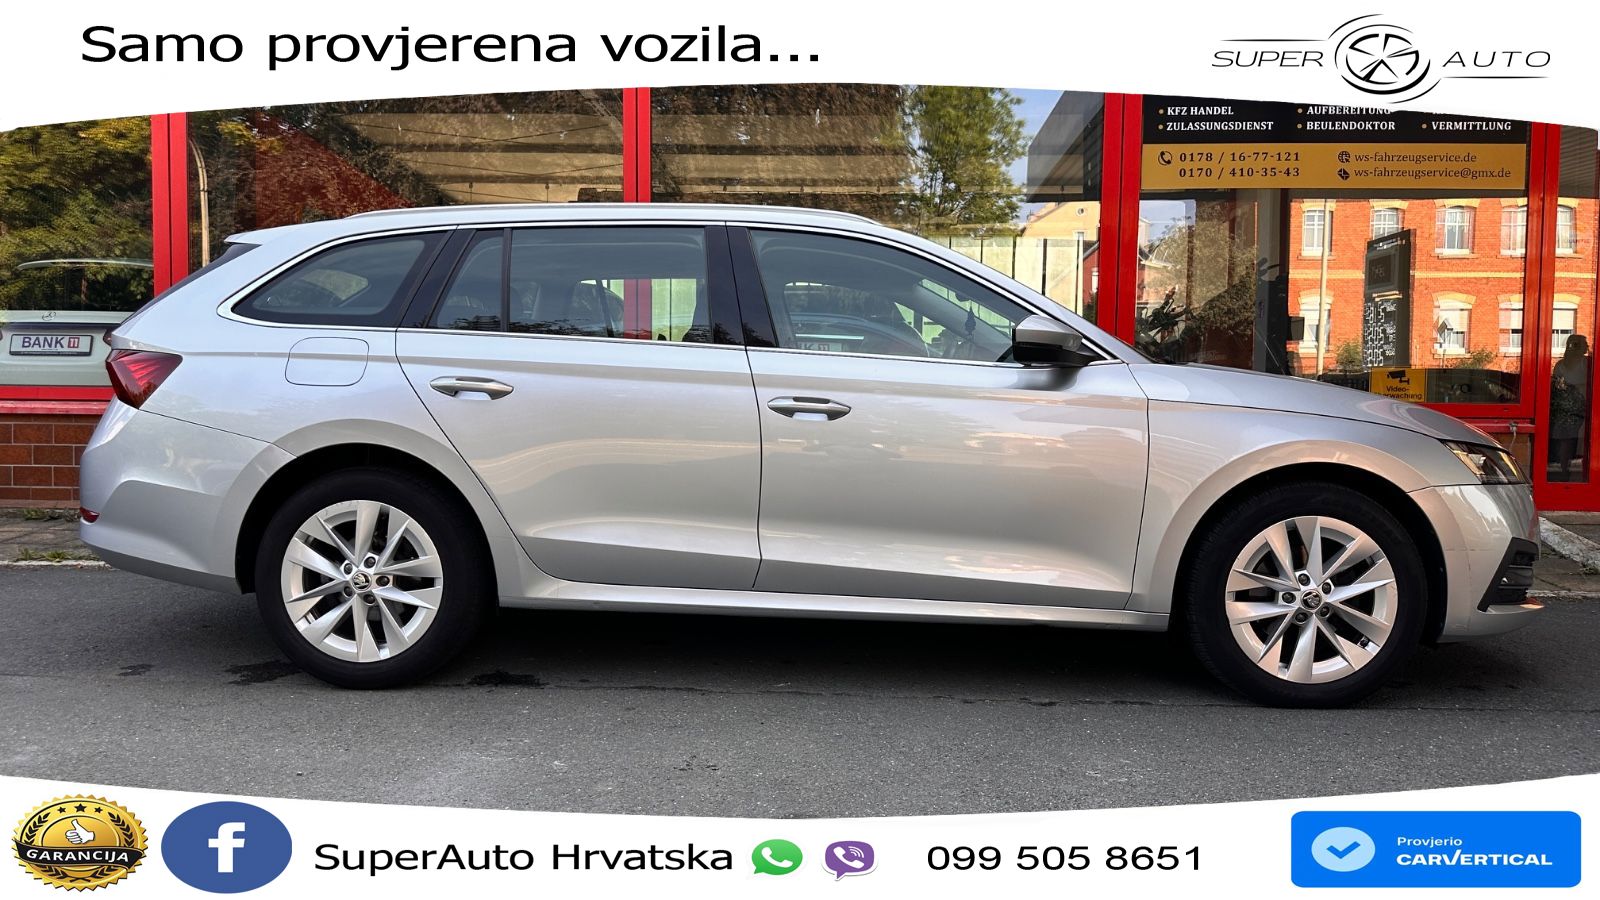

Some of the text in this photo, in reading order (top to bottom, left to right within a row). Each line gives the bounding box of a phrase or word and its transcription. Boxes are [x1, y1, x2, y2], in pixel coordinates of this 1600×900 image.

[1167, 105, 1234, 116] KFZ HANDEL
[1166, 121, 1274, 131] ZULASSUNGSDIENST
[1306, 121, 1396, 131] BEULENDOKTOR
[1431, 121, 1512, 131] VERMITTLUNG
[1179, 151, 1300, 165] 0178 / 16-77-121
[1354, 151, 1477, 166] ws-fahrzeugservice.de
[1178, 167, 1300, 181] 0170 / 410-35-43
[1353, 166, 1512, 181] ws-fahrzeugservice@gmx.de
[22, 336, 65, 349] BANK
[1386, 385, 1409, 393] Video-
